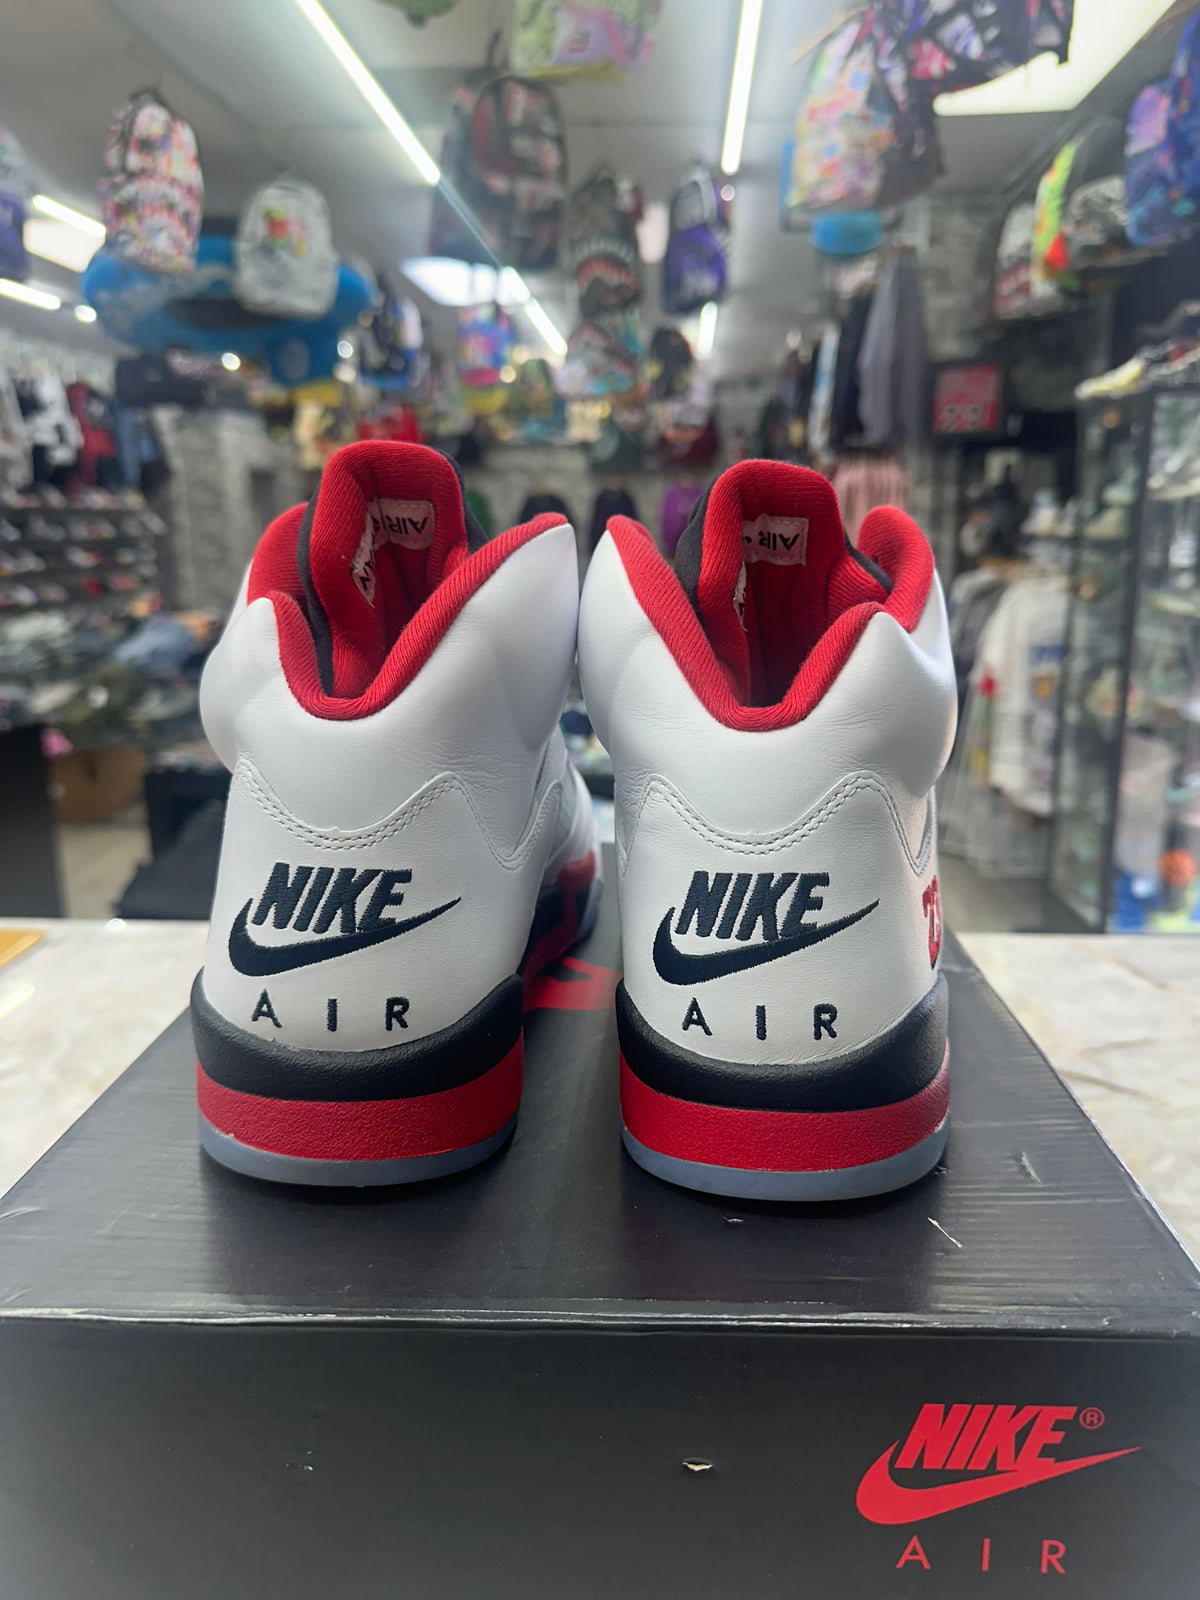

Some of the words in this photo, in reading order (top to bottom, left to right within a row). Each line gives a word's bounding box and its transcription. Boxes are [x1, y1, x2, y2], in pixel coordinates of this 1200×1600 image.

[385, 515, 428, 535] AIR
[758, 530, 800, 551] AIR
[252, 862, 412, 934] NIKE
[675, 870, 830, 941] NIKE
[252, 988, 410, 1032] AIR
[682, 997, 838, 1041] AIR
[894, 1403, 1078, 1471] NIKE
[896, 1535, 1067, 1575] AIR
